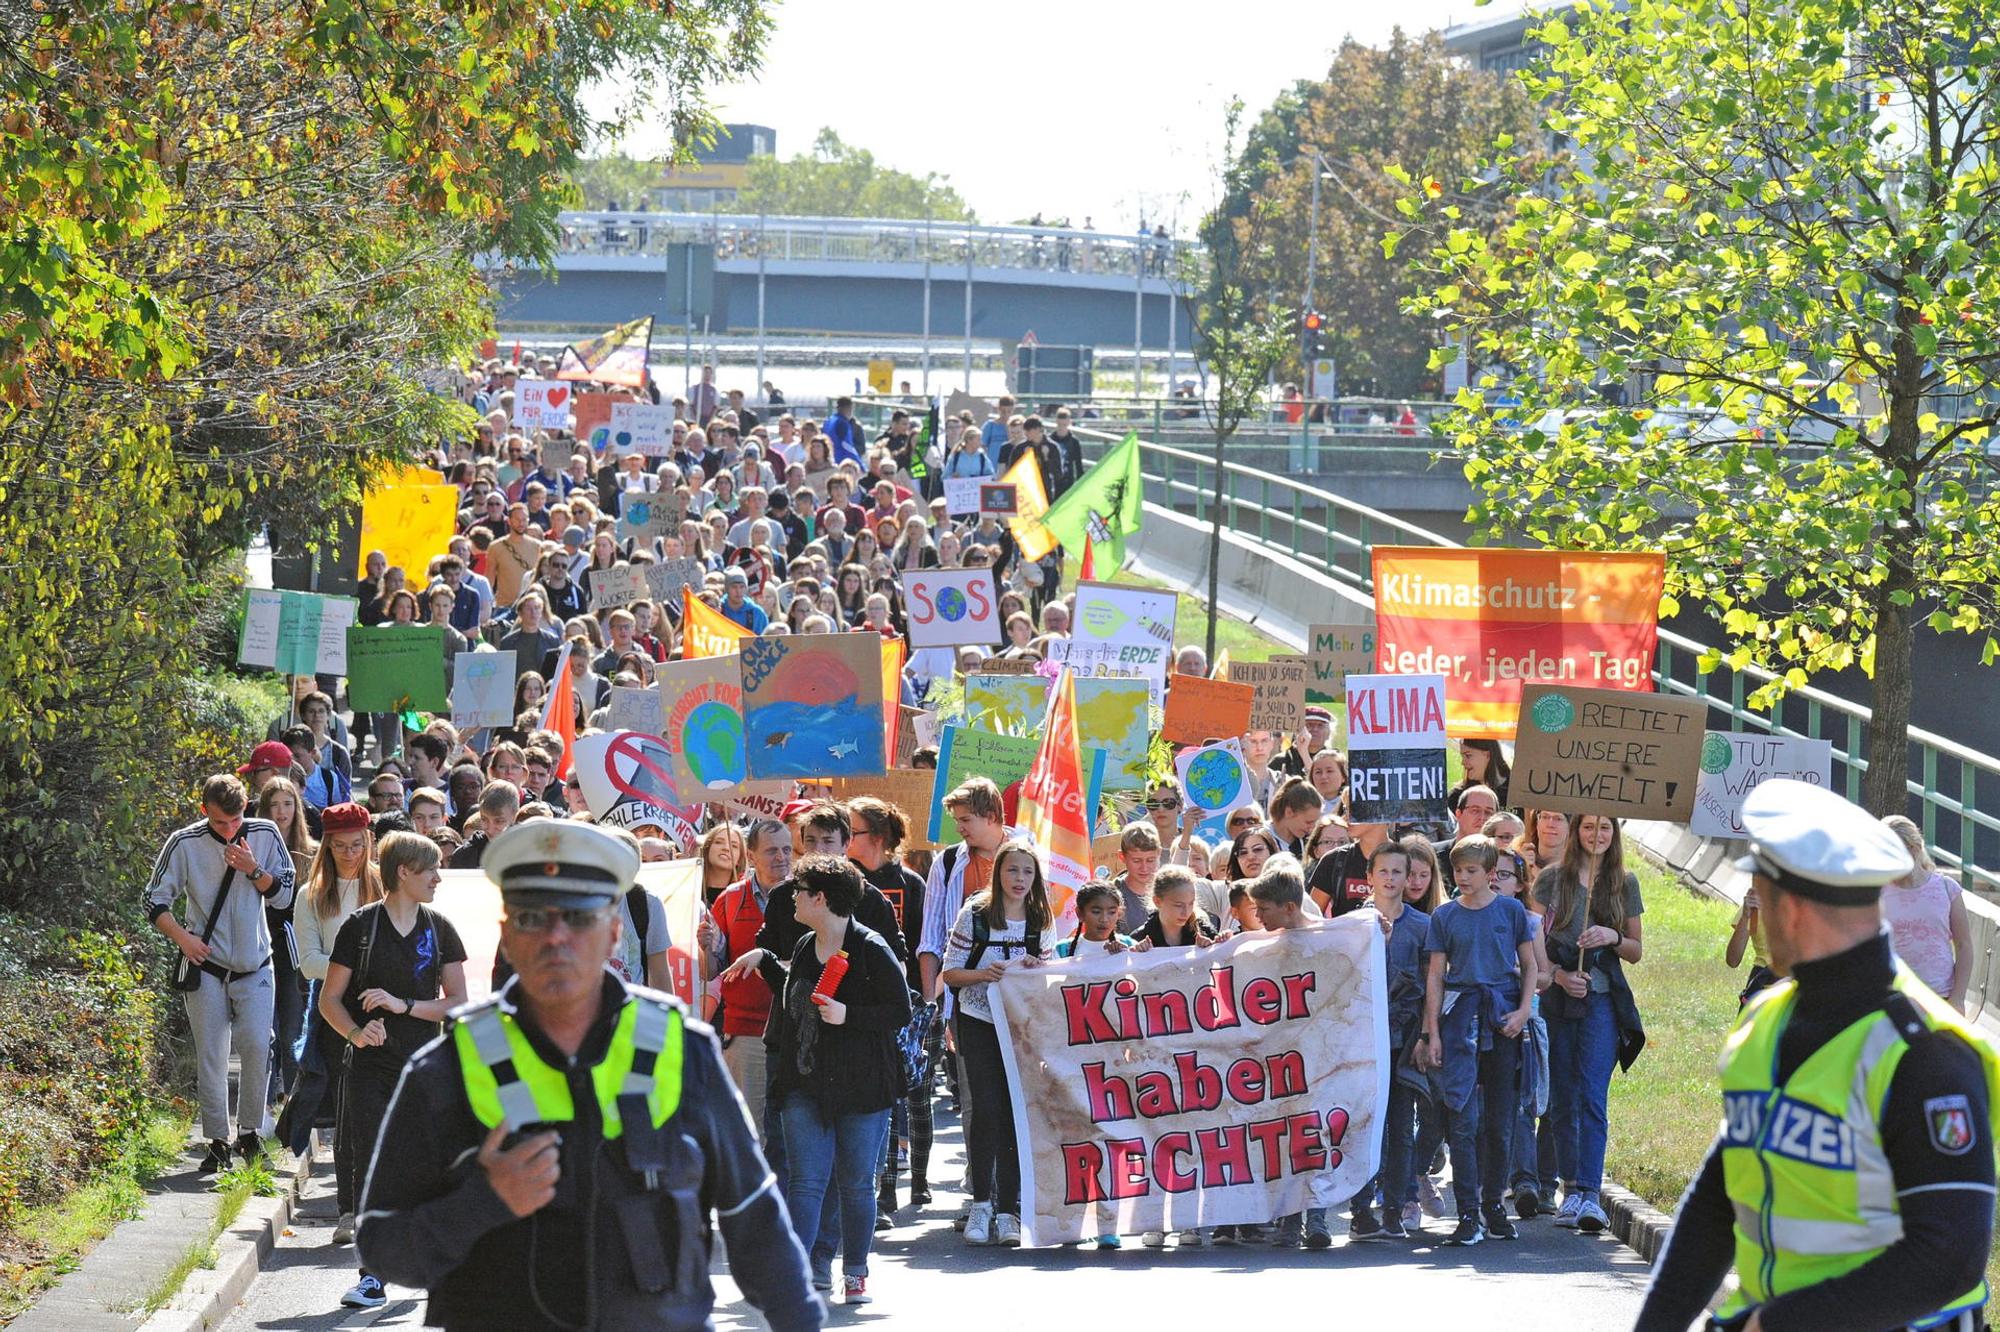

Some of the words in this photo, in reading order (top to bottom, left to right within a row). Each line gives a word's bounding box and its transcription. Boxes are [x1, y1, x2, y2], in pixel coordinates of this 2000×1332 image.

[1381, 573, 1576, 609] Klimaschutz
[742, 636, 771, 667] OUR
[743, 639, 790, 692] CHOICE
[1119, 646, 1160, 663] ERDE
[1383, 643, 1473, 683] Jeder,
[1482, 648, 1576, 688] jeden
[1589, 650, 1648, 688] Tag!
[1233, 666, 1249, 681] ICH
[1252, 667, 1266, 683] BIN
[1250, 714, 1300, 732] EBASTELT!
[1347, 686, 1445, 735] KLIMA
[1581, 702, 1689, 733] RETTET
[1555, 739, 1661, 766] UNSERE
[1734, 740, 1785, 767] TUT
[1350, 766, 1444, 802] RETTEN!
[1061, 965, 1316, 1046] Kinder
[1081, 1049, 1309, 1124] haben
[1061, 1107, 1350, 1206] RECHTE!
